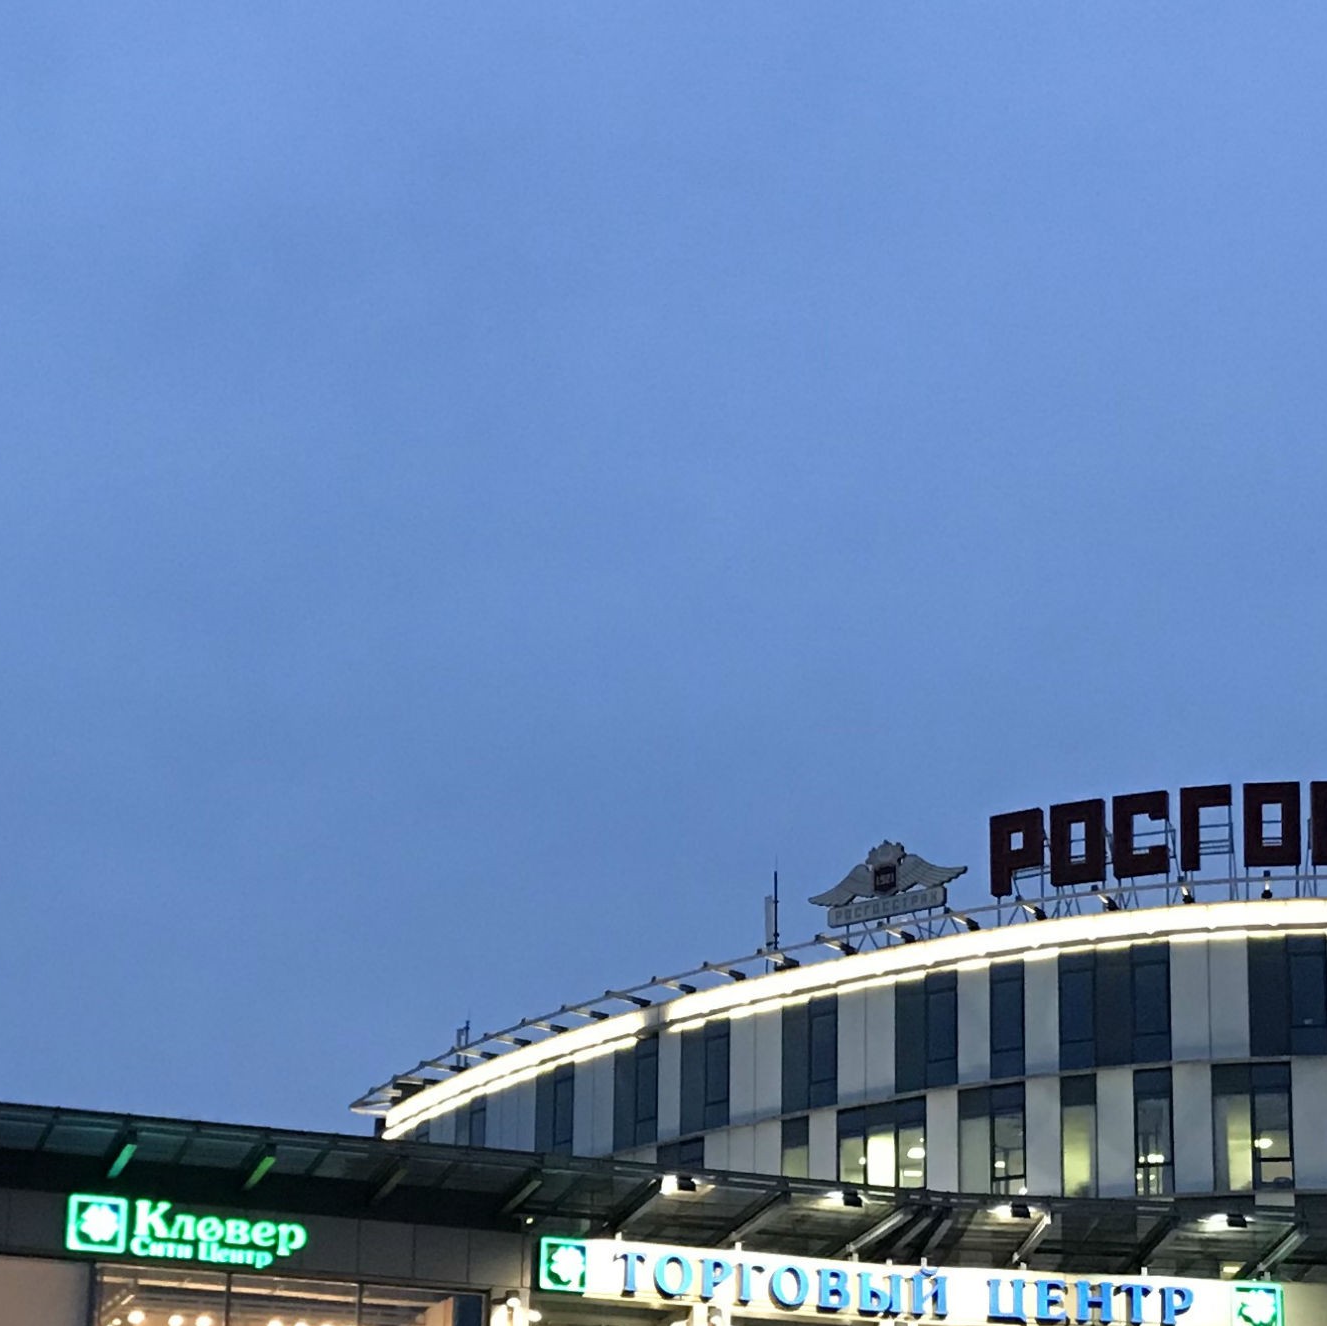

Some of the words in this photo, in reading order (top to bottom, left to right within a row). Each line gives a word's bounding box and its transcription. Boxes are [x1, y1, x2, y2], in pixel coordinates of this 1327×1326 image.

[130, 1236, 194, 1261] Сити
[198, 1245, 273, 1269] Центр
[134, 1201, 307, 1256] Кловер
[614, 1252, 948, 1317] ТОРГОВЫЙ
